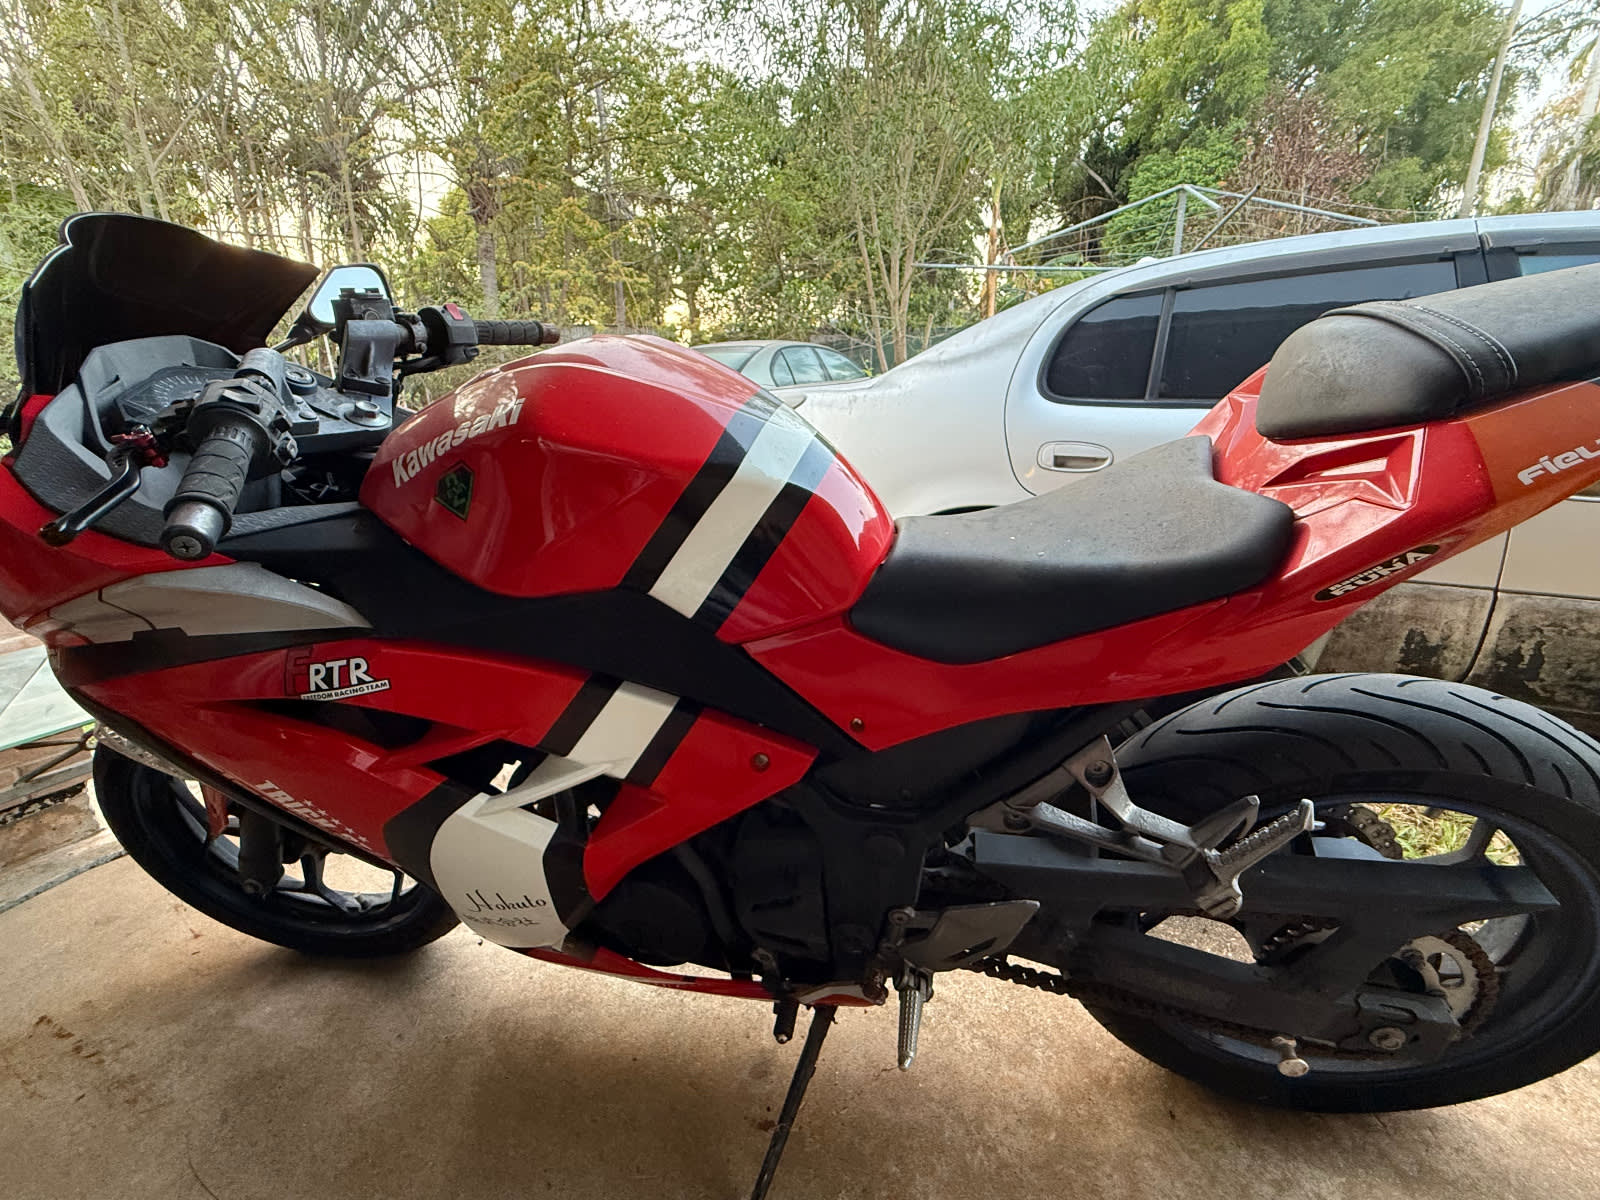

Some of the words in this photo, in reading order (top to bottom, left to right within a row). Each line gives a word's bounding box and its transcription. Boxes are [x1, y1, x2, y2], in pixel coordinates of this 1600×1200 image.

[392, 398, 526, 488] Kawasaki
[334, 686, 366, 698] RACING
[365, 681, 388, 691] TEAM
[467, 889, 547, 912] Hokuto
